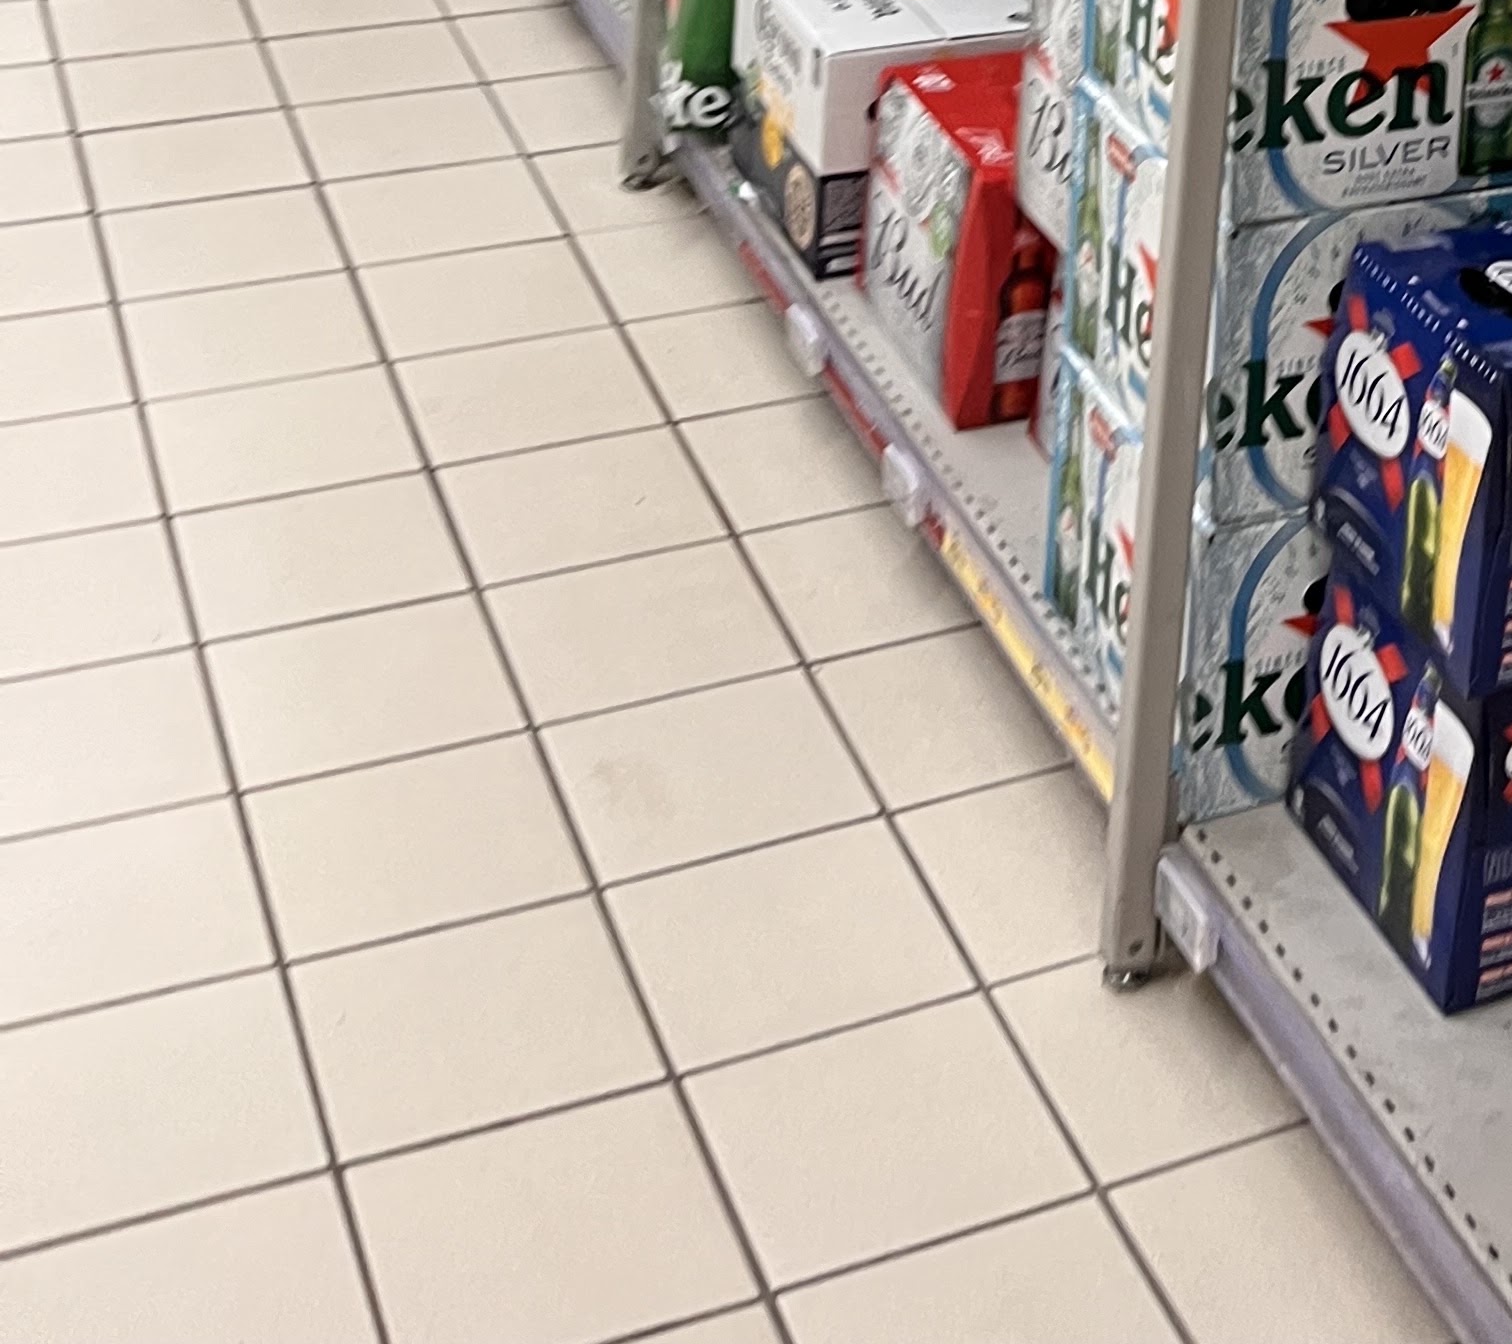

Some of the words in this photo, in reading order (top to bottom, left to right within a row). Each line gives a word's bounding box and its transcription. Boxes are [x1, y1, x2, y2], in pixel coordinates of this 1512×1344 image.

[1323, 136, 1451, 175] SILVER
[1337, 348, 1405, 443] 1664
[1322, 641, 1392, 741] 1664
